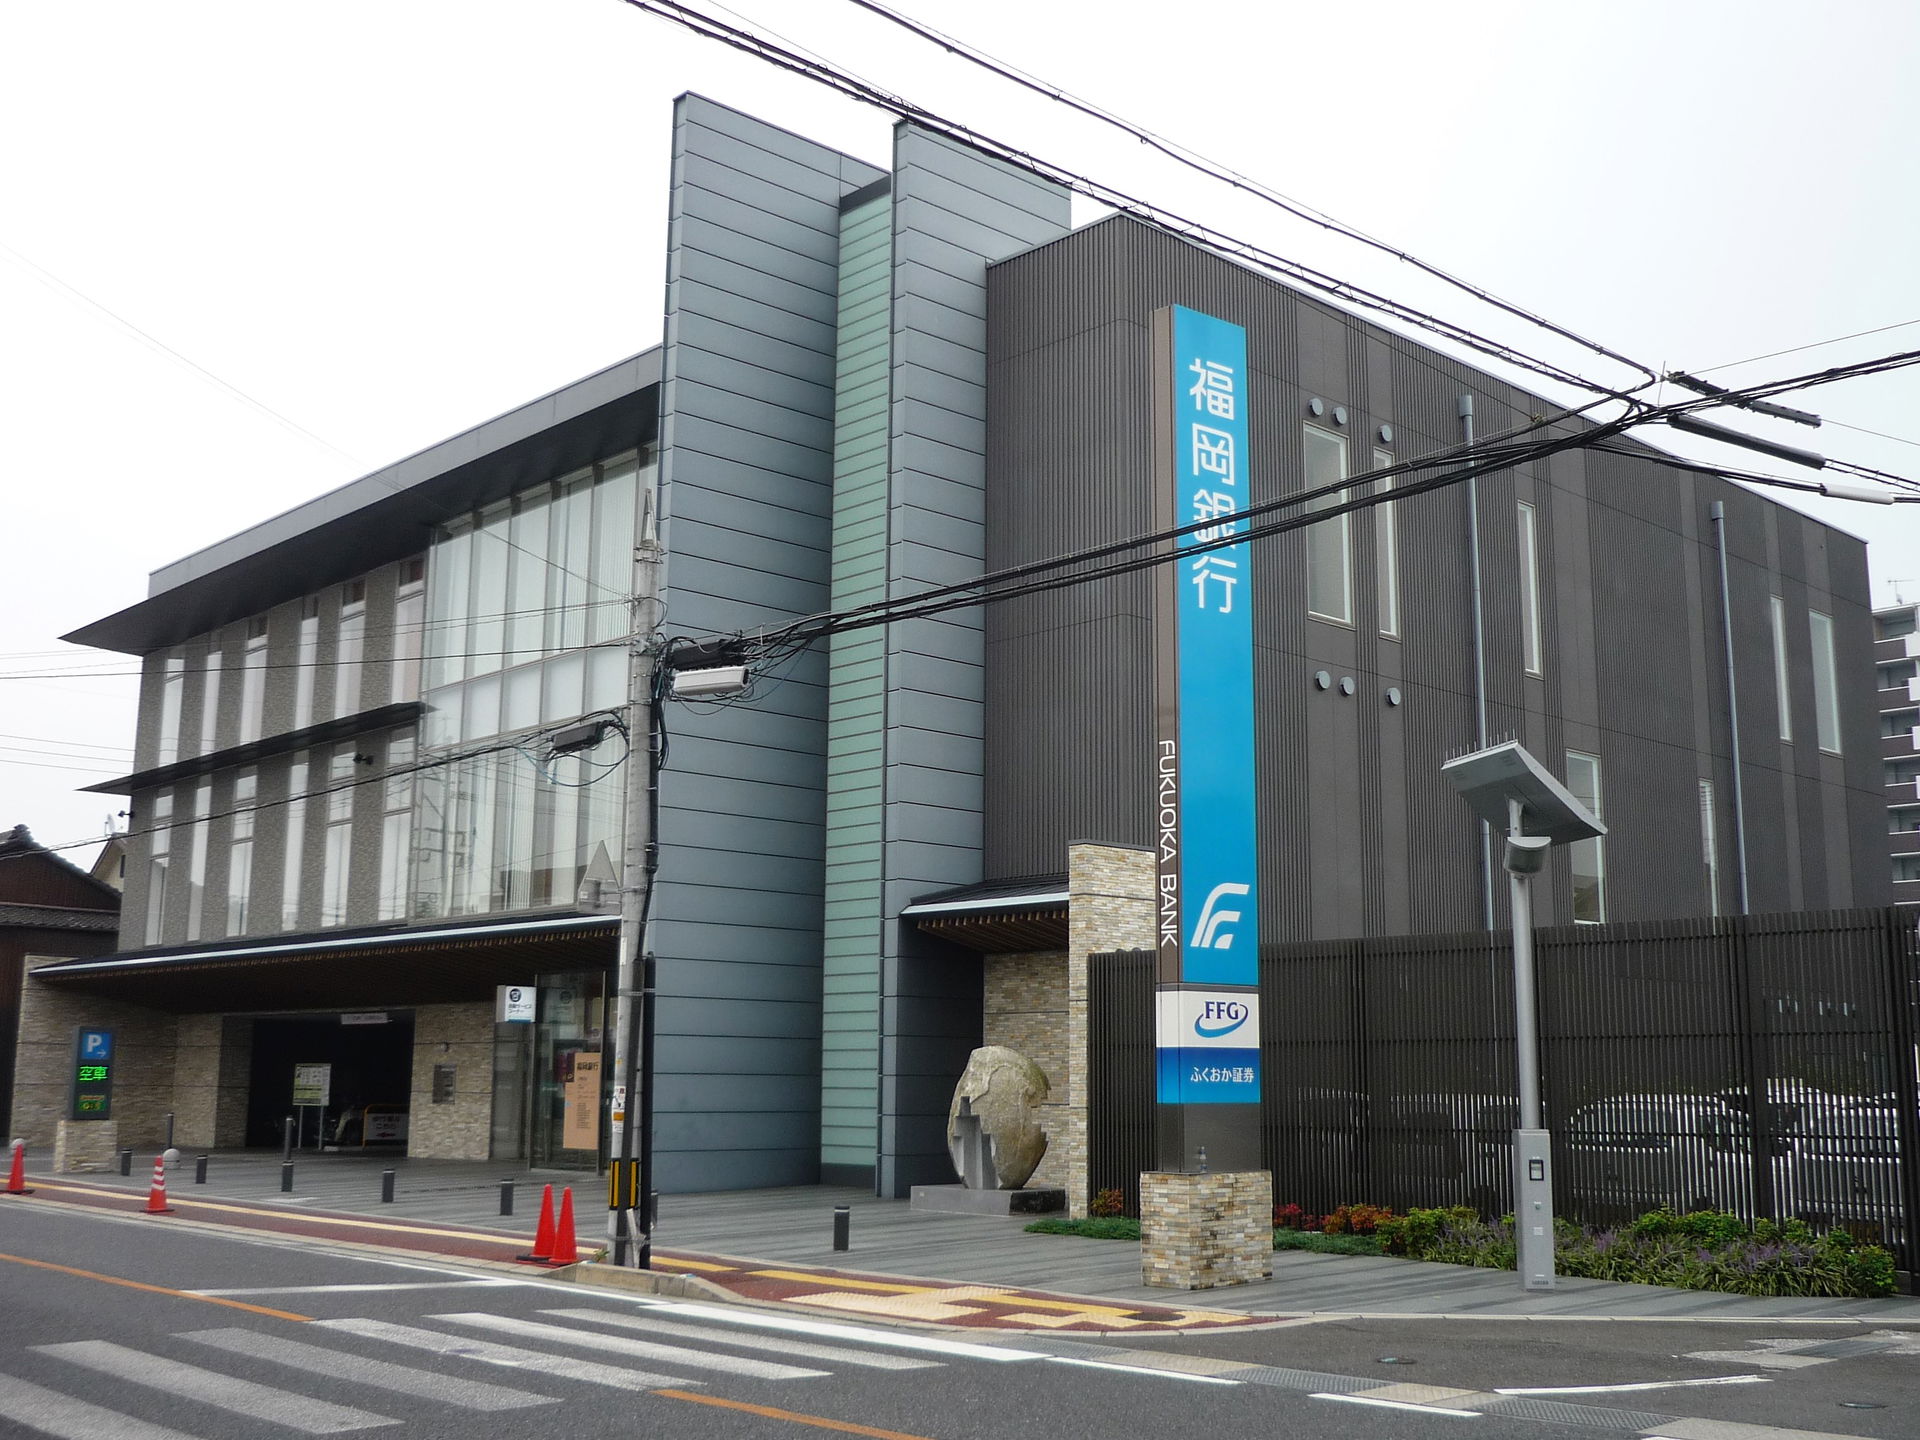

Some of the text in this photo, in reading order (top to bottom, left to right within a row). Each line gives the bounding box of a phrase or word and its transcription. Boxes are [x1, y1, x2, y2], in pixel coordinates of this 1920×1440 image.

[1188, 357, 1237, 614] 福岡銀行
[1158, 740, 1178, 948] FUKUOKA BANK
[1204, 1000, 1239, 1020] FFG
[87, 1034, 103, 1053] P
[79, 1065, 109, 1081] 空車
[1190, 1066, 1255, 1083] ふくおか証券
